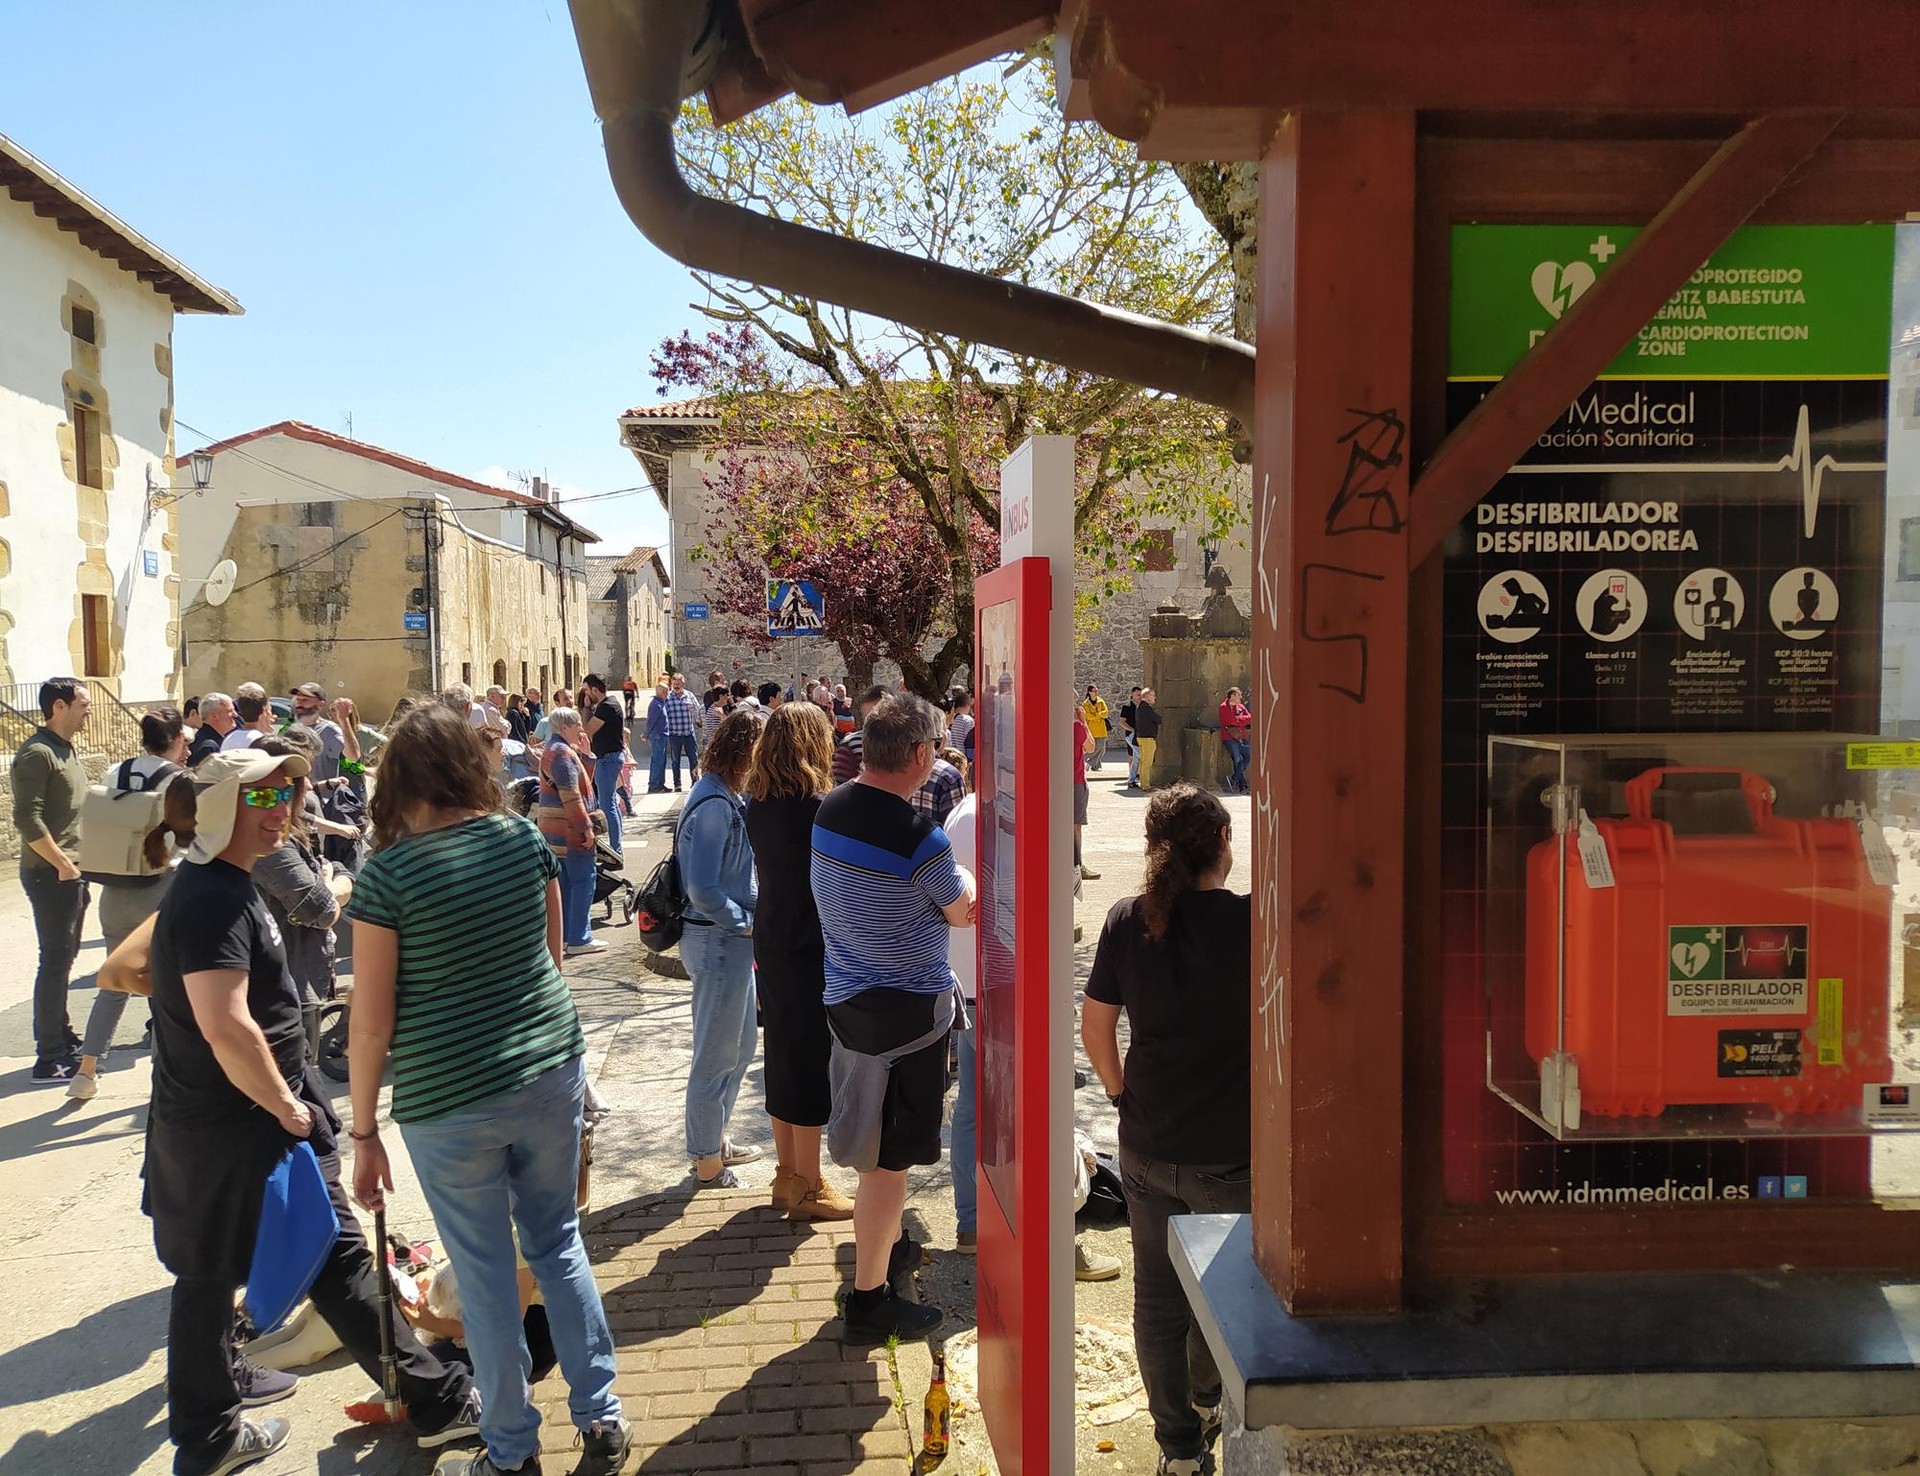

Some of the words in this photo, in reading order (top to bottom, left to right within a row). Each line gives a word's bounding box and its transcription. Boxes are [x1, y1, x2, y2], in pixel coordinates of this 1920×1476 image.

[1690, 269, 1803, 284] OPROTEGIDO
[1668, 290, 1701, 304] OTZ
[1706, 289, 1806, 304] BABESTUTA
[1654, 305, 1707, 319] EMUA
[1638, 325, 1808, 340] CARDIOPROTECTION
[1637, 341, 1686, 356] ZONE
[1568, 391, 1694, 424] Medical
[1538, 428, 1598, 448] ación
[1603, 429, 1694, 447] Sanitaria
[1477, 502, 1679, 525] DESFIBRILADOR
[1476, 530, 1699, 553] DESFIBRILADOREA
[1612, 584, 1625, 593] 112
[1476, 652, 1502, 661] Evalúe
[1504, 652, 1549, 660] consciencia
[1610, 651, 1619, 659] al
[1620, 651, 1636, 659] 112
[1774, 649, 1790, 657] RCP
[1811, 649, 1833, 657] hasta
[1486, 662, 1492, 670] y
[1493, 660, 1538, 670] respiración
[1614, 664, 1627, 672] 112
[1778, 659, 1794, 667] que
[1820, 657, 1829, 665] la
[1596, 677, 1610, 685] Call
[1528, 700, 1542, 709] and
[1672, 983, 1803, 997] DESFIBRILADOR
[1682, 999, 1715, 1007] EQUIPO
[1718, 998, 1729, 1006] DE
[1732, 997, 1795, 1006] REANIMACIÓN
[1495, 1177, 1750, 1205] www.idmmedical.es
